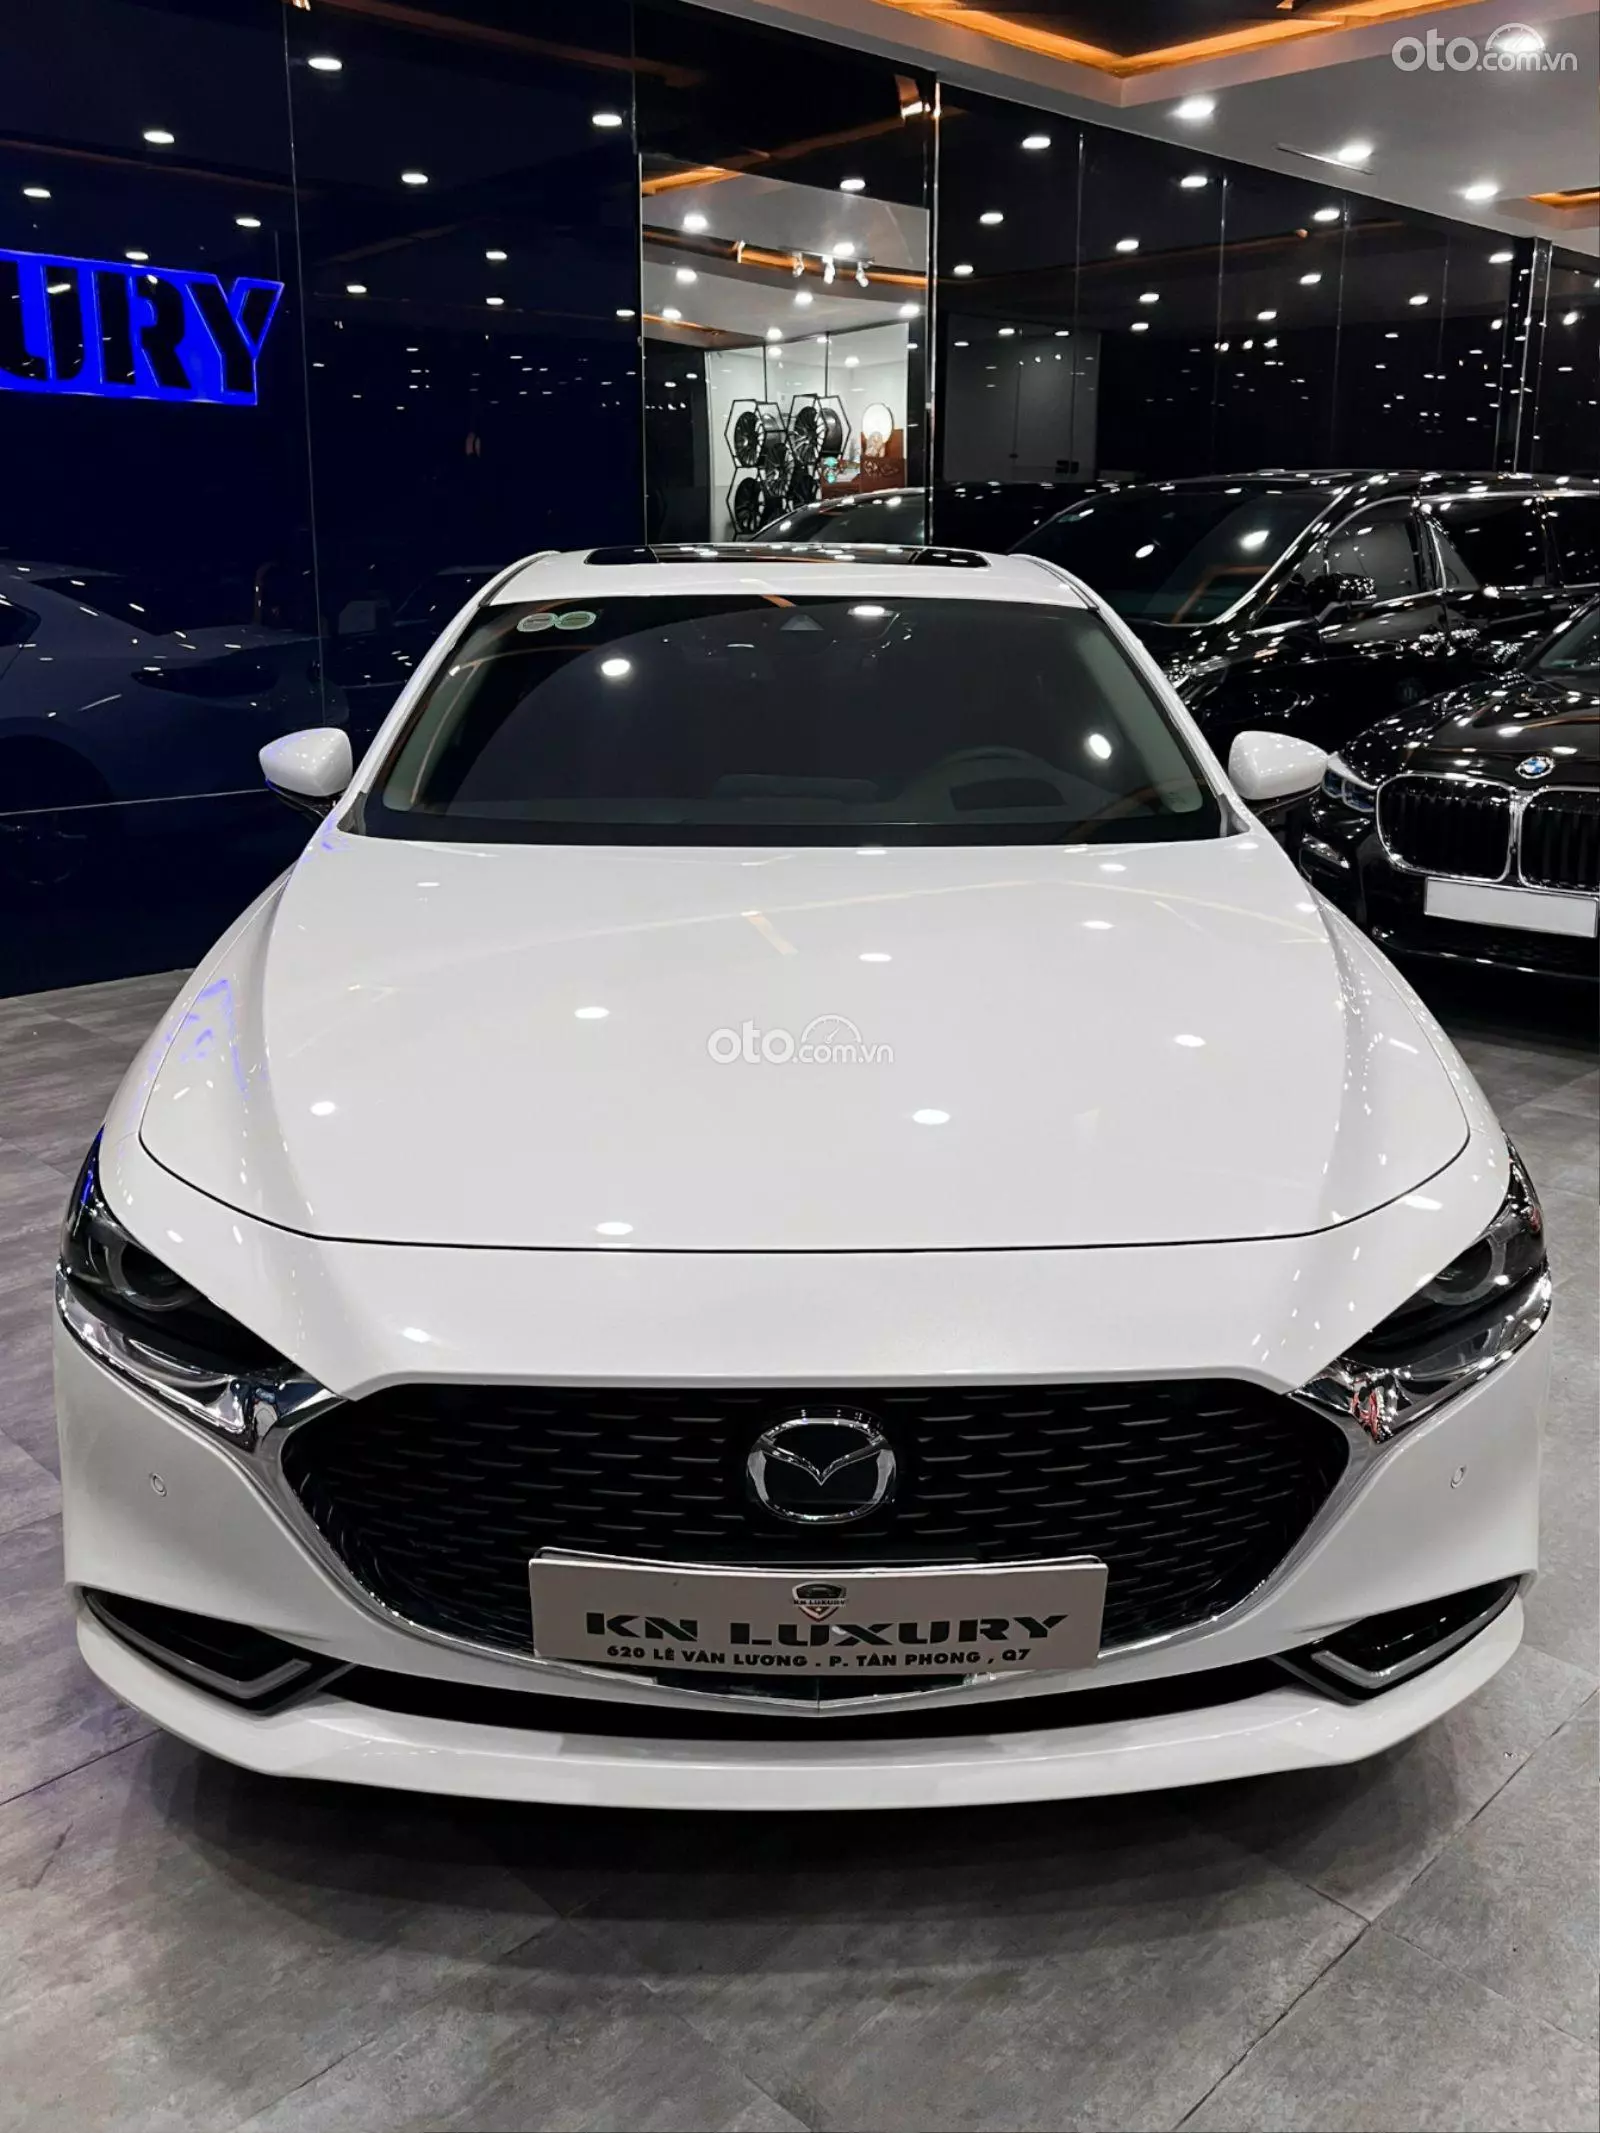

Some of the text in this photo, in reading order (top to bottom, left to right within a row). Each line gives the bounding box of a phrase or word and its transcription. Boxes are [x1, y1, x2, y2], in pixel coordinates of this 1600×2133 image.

[586, 1612, 1069, 1647] KN LUXURY
[606, 1645, 646, 1658] 620
[653, 1647, 675, 1661] LÊ
[904, 1651, 981, 1666] PHONG
[1002, 1648, 1031, 1662] Q7
